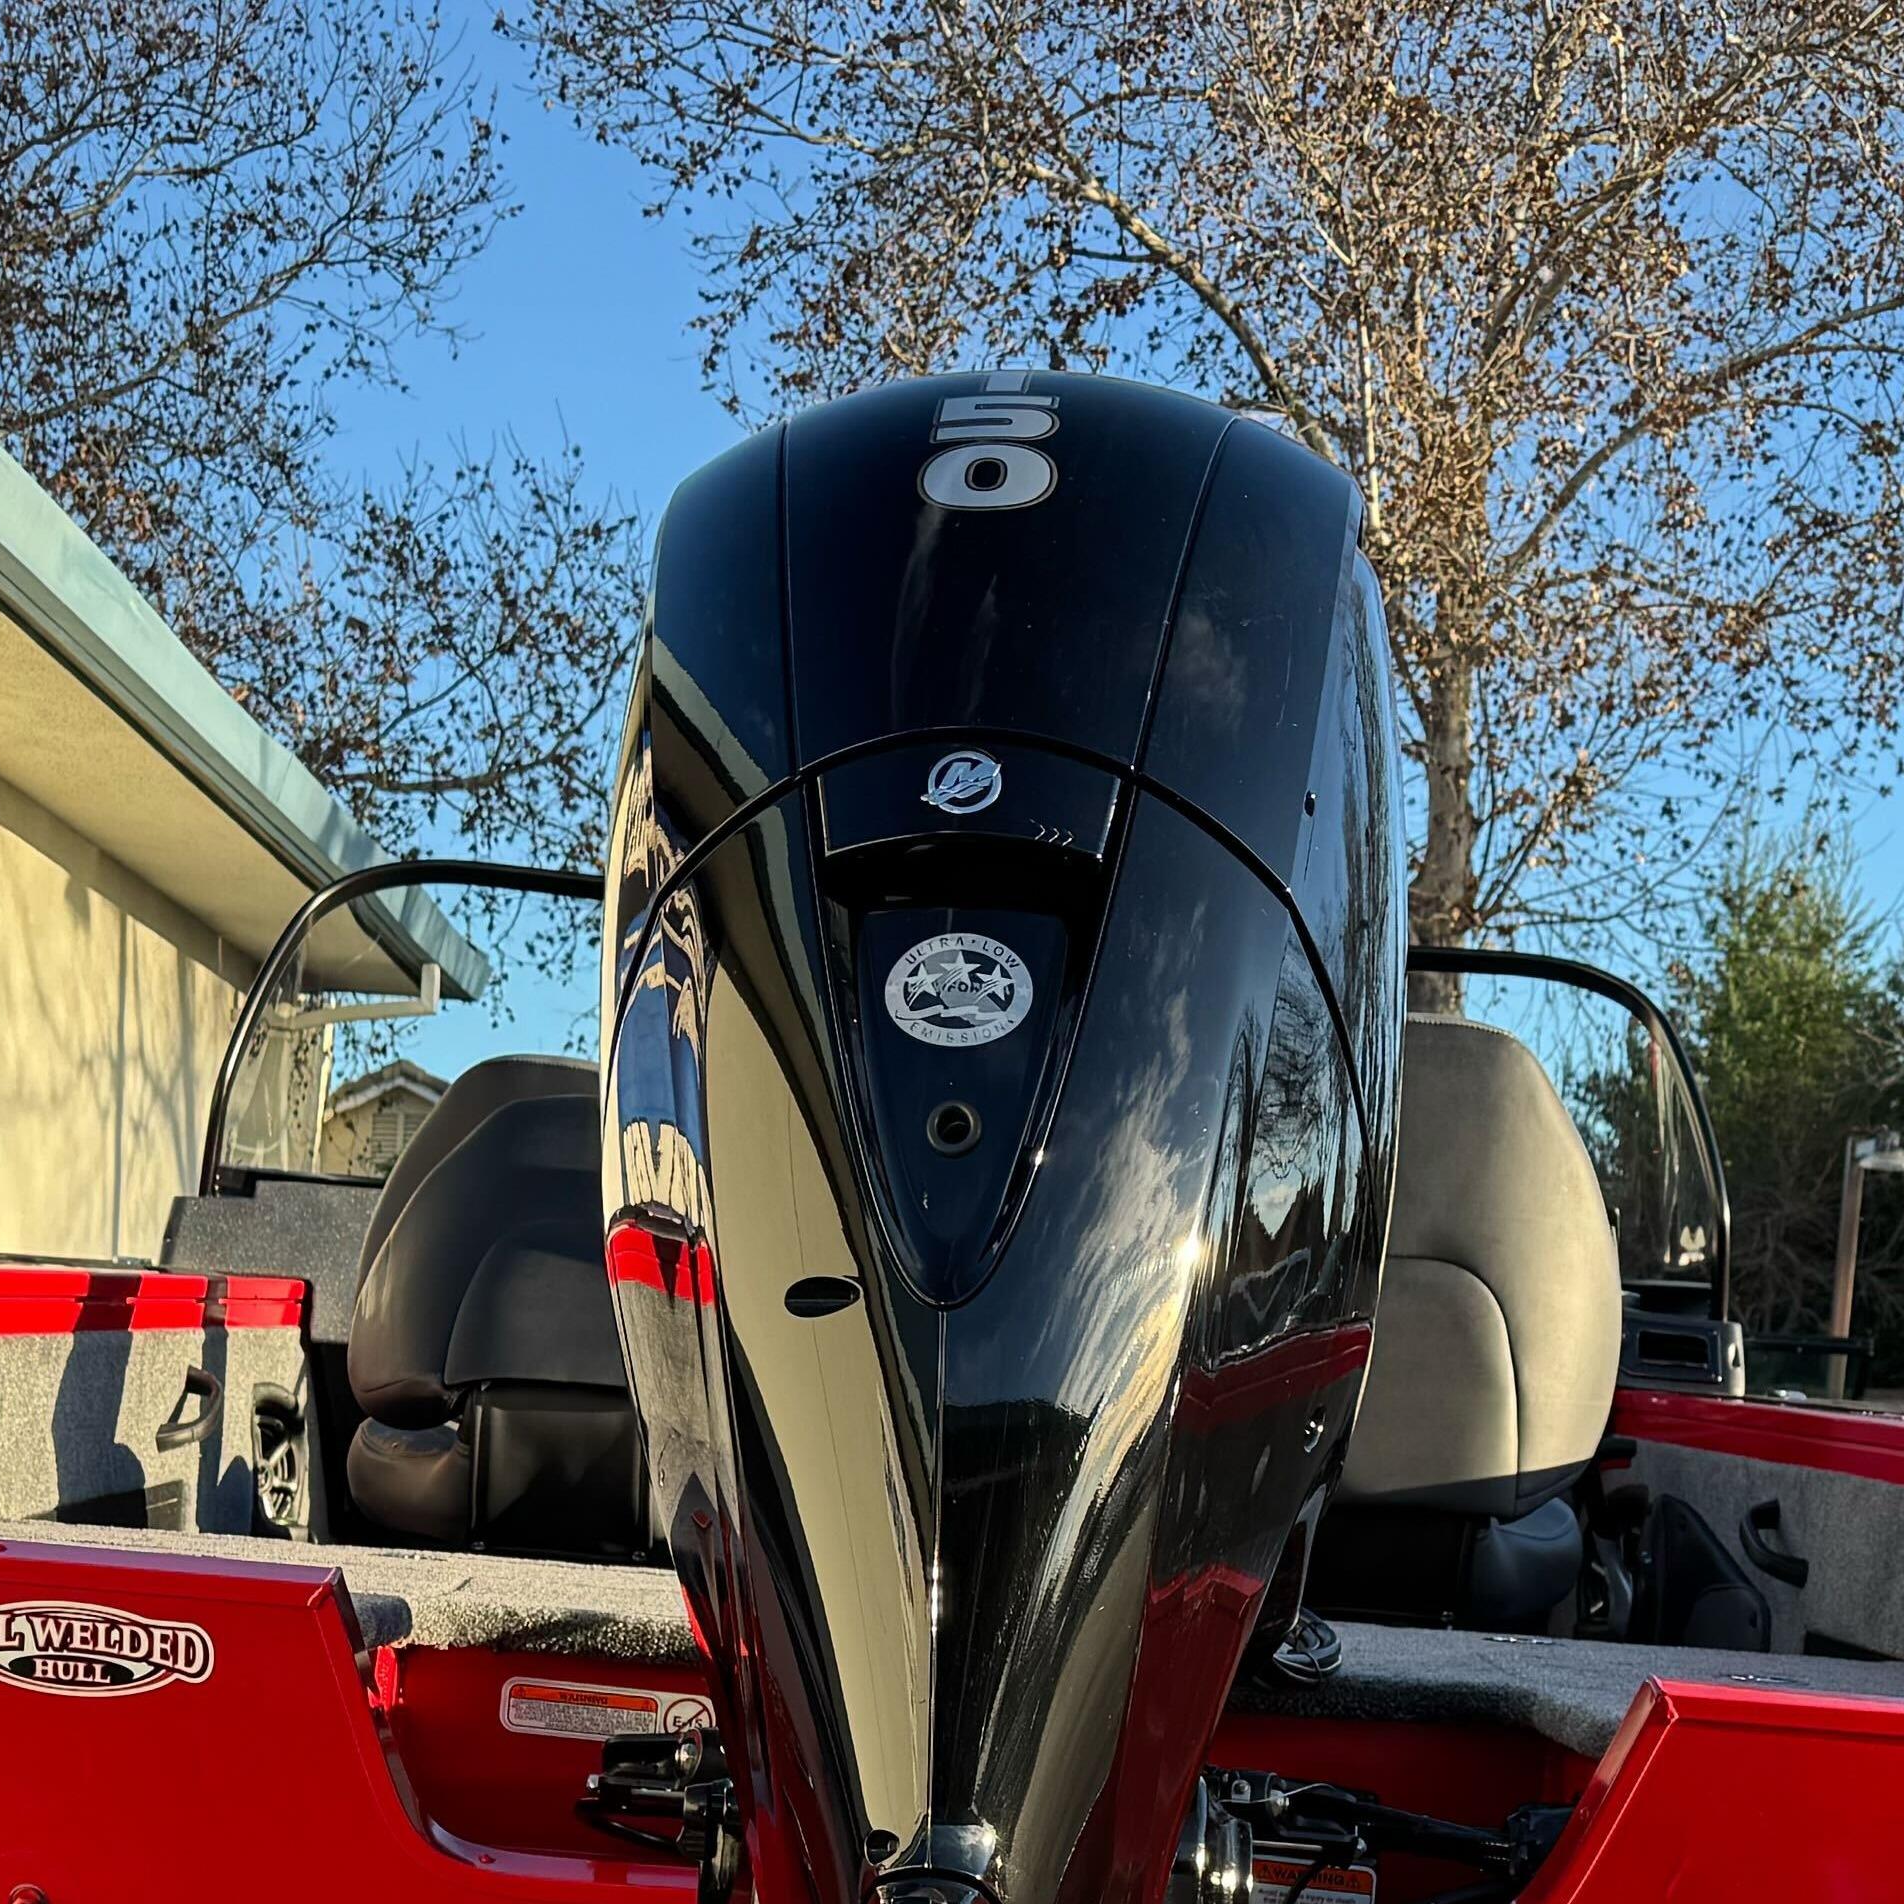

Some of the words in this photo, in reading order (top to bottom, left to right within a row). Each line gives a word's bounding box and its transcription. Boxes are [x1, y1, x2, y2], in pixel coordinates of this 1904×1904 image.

[29, 1615, 205, 1674] WELDED
[33, 1657, 111, 1684] HULL
[1274, 1866, 1345, 1886] WANING
